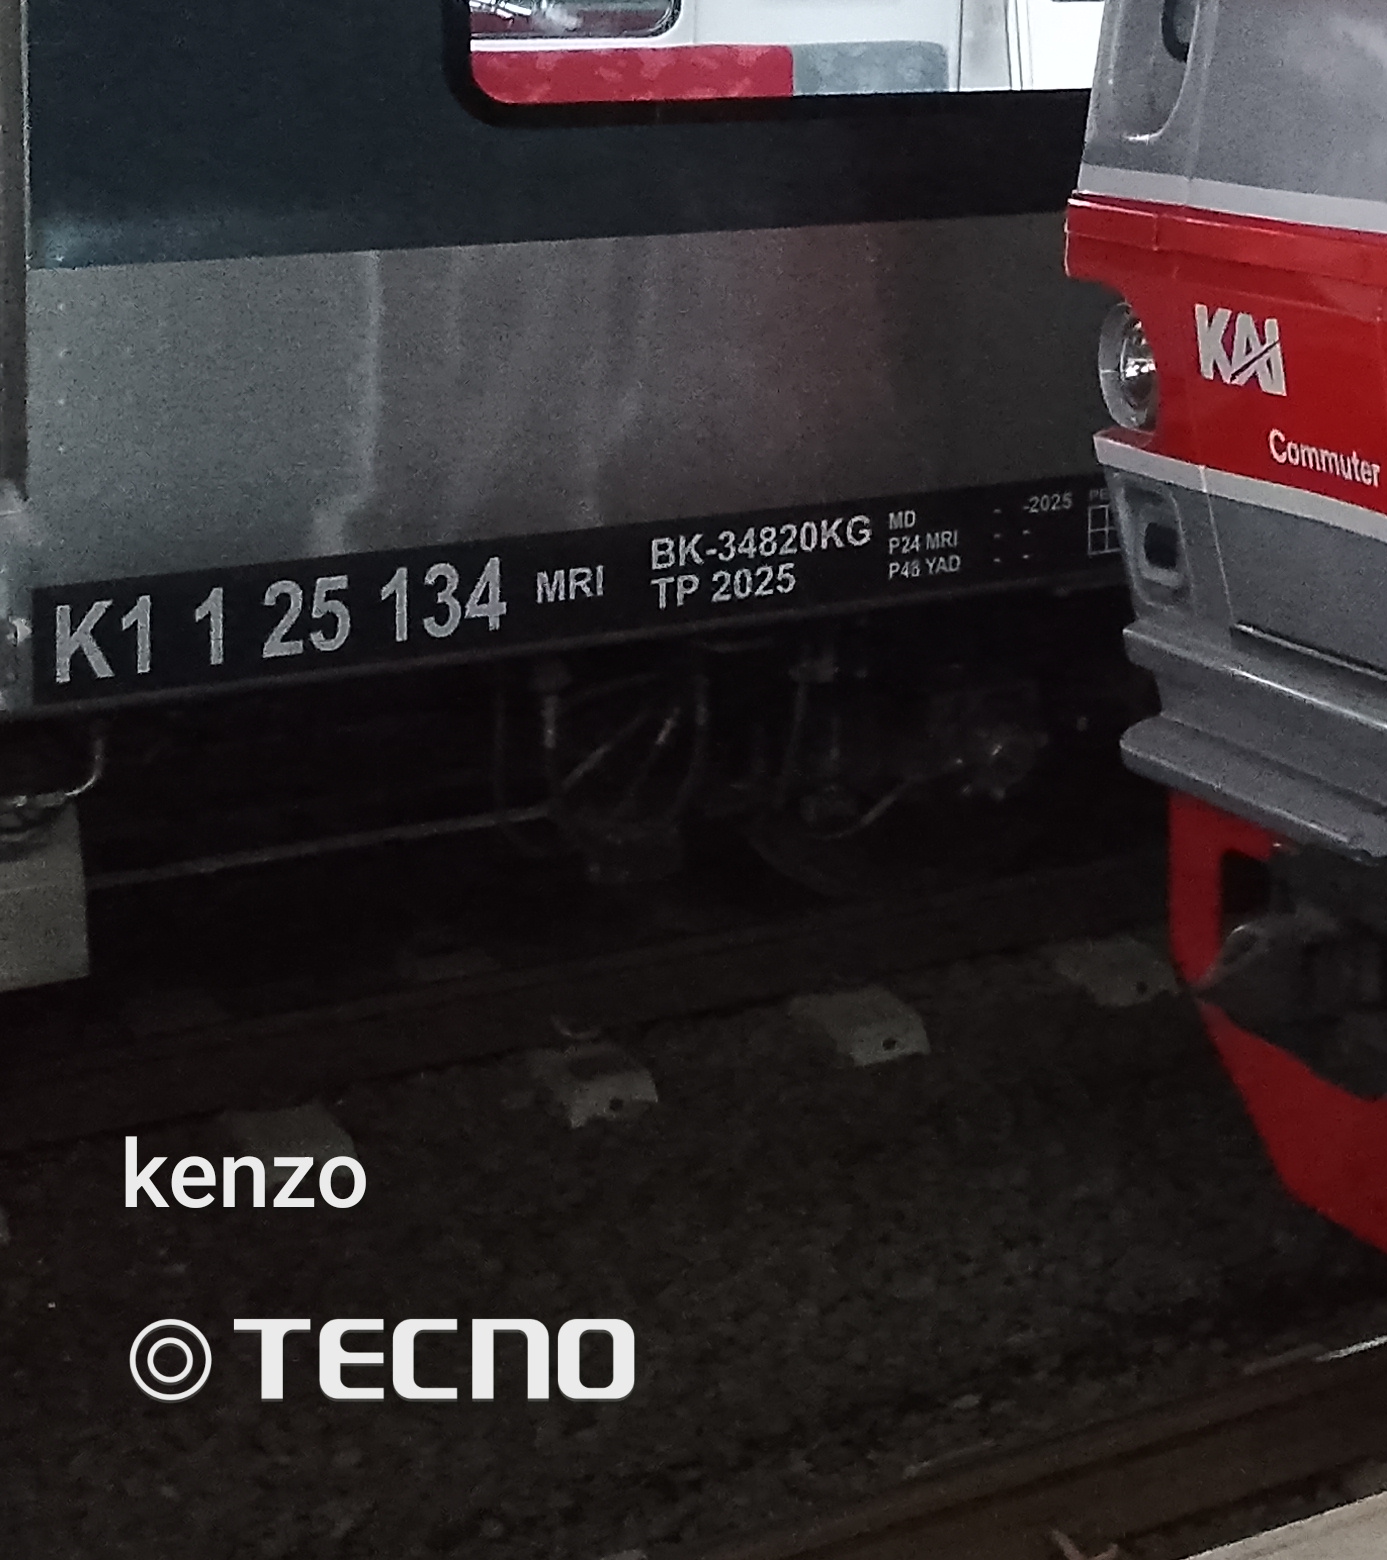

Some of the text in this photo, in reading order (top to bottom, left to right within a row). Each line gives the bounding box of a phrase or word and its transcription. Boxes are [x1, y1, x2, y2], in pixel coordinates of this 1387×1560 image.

[1194, 303, 1288, 397] KAI
[1268, 428, 1381, 487] Commuter
[650, 514, 872, 571] BK-34820KG
[889, 510, 916, 530] MD
[889, 530, 958, 555] P24 MRI
[651, 562, 797, 610] TP 2025
[925, 554, 961, 574] YAD
[55, 556, 604, 683] K1 1 25 134 MRI
